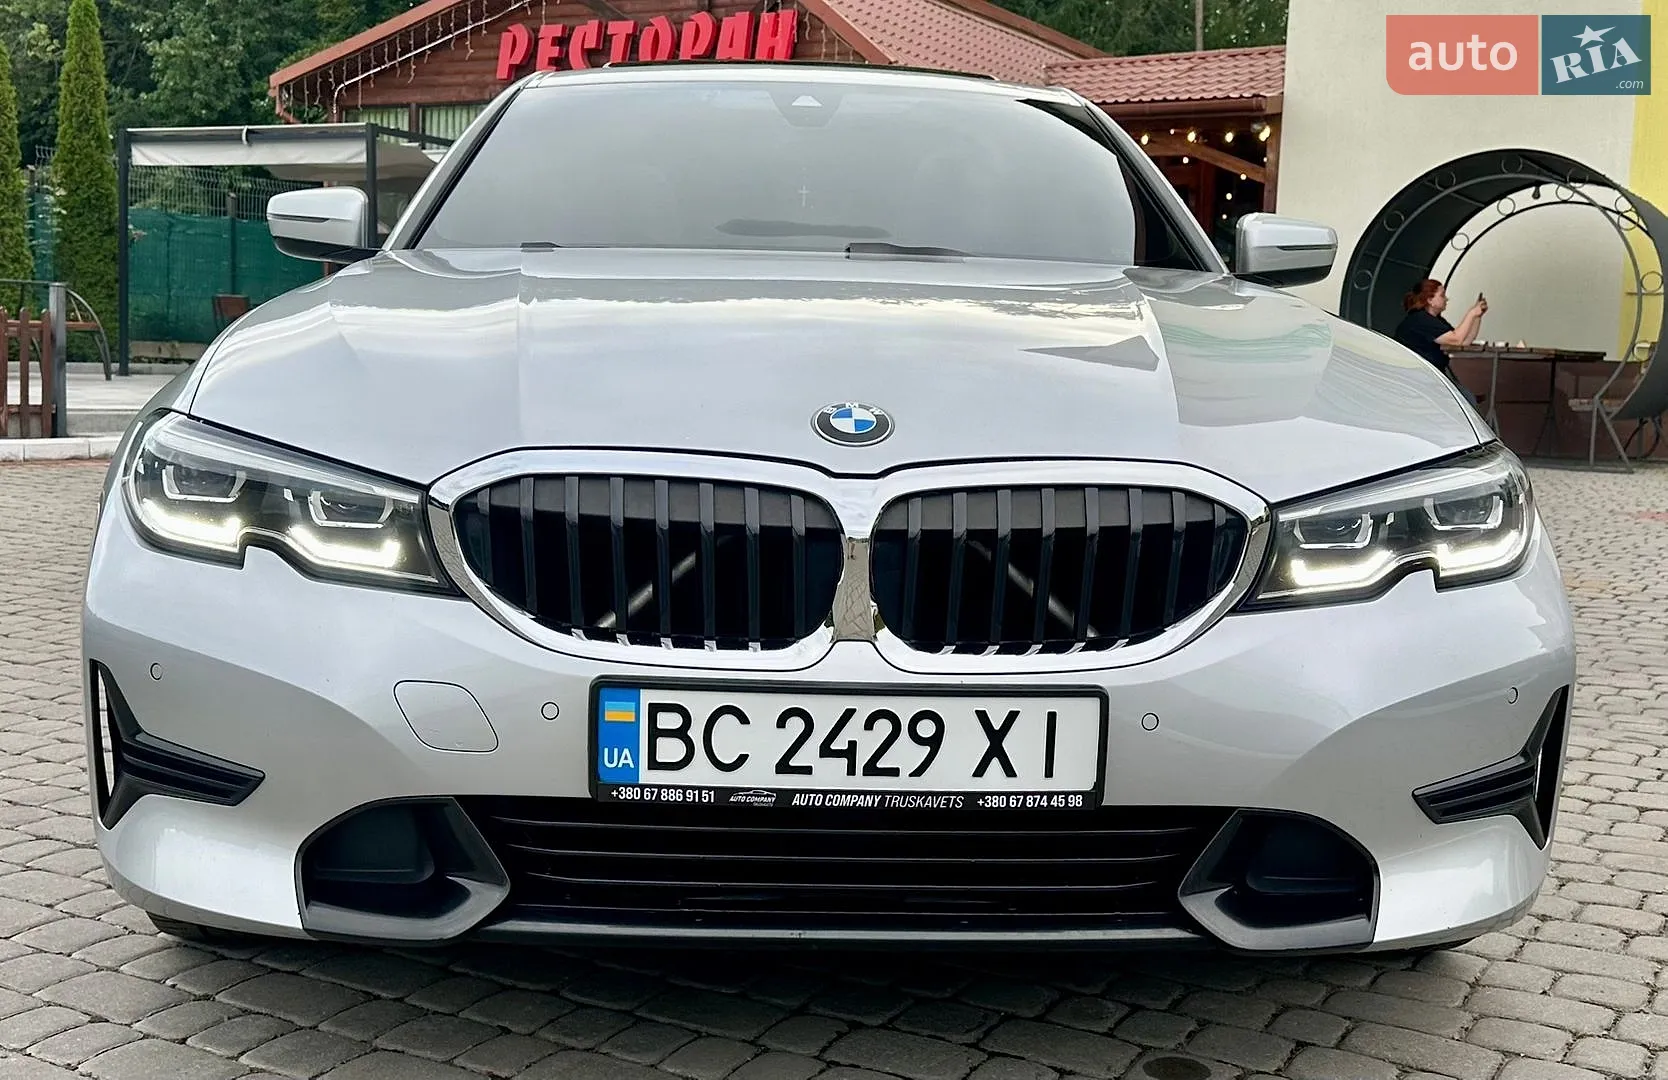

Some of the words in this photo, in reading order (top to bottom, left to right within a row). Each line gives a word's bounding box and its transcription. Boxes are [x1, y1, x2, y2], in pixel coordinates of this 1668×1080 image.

[496, 9, 798, 80] РЕСТОРАН
[647, 702, 751, 773] BC
[775, 706, 946, 778] 2429
[603, 747, 635, 769] UA
[611, 787, 641, 800] +380
[643, 788, 659, 801] 67
[660, 788, 683, 802] 886
[685, 789, 699, 803] 91
[701, 790, 716, 803] 51
[791, 793, 823, 806] AUTO
[824, 794, 882, 807] COMPANY
[884, 795, 965, 809] TRUSKAVETS
[977, 795, 1007, 808] +380
[1009, 795, 1024, 808] 67
[1026, 795, 1048, 808] 874
[1050, 795, 1066, 808] 45
[1067, 794, 1083, 807] 98
